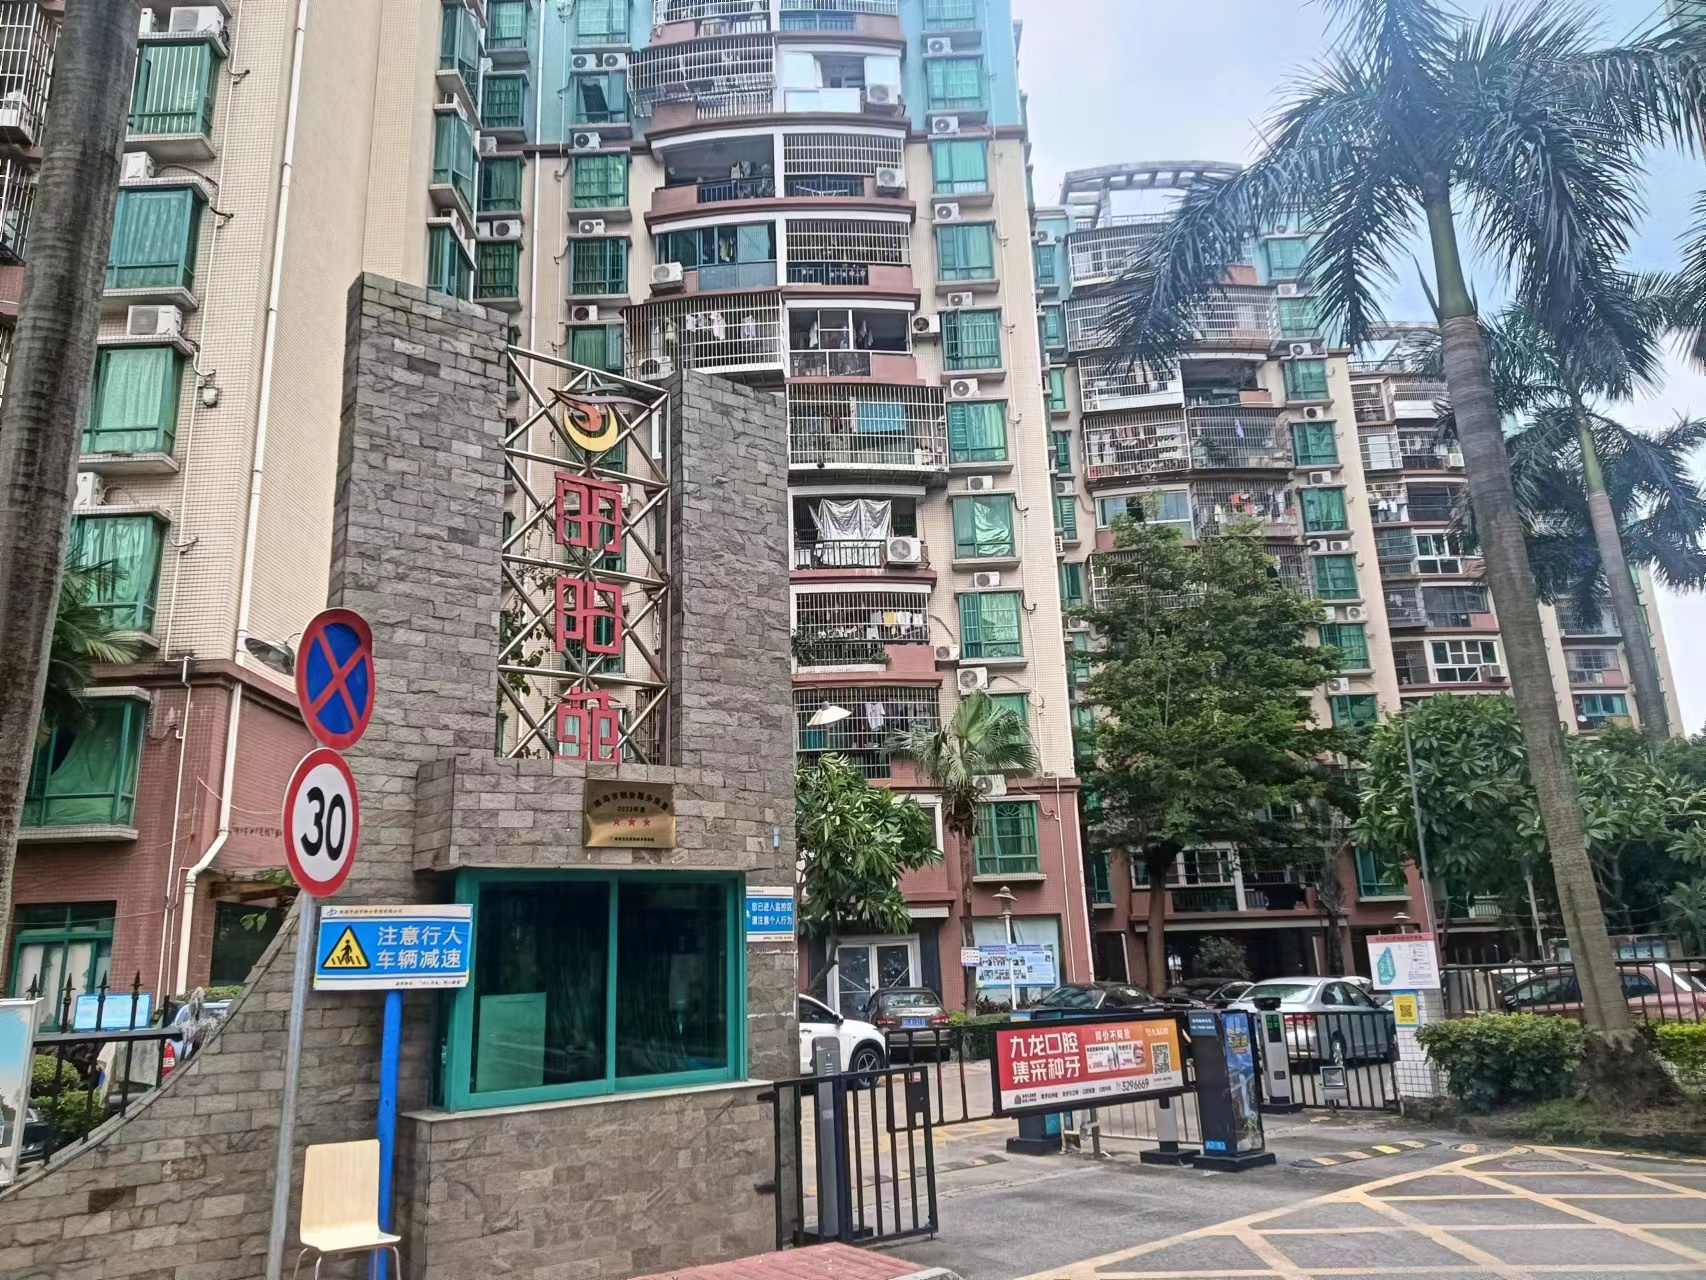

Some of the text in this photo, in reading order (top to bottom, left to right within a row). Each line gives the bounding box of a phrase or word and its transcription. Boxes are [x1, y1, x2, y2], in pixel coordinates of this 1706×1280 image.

[300, 786, 346, 862] 30
[751, 902, 792, 912] 您已进入监控区
[751, 915, 793, 926] 请注意个人行为
[377, 925, 462, 946] 注意行人
[376, 948, 462, 970] 车辆减速
[1010, 1031, 1080, 1058] 九龙口腔
[1012, 1056, 1081, 1084] 集采种牙
[1121, 1078, 1150, 1092] 3296669
